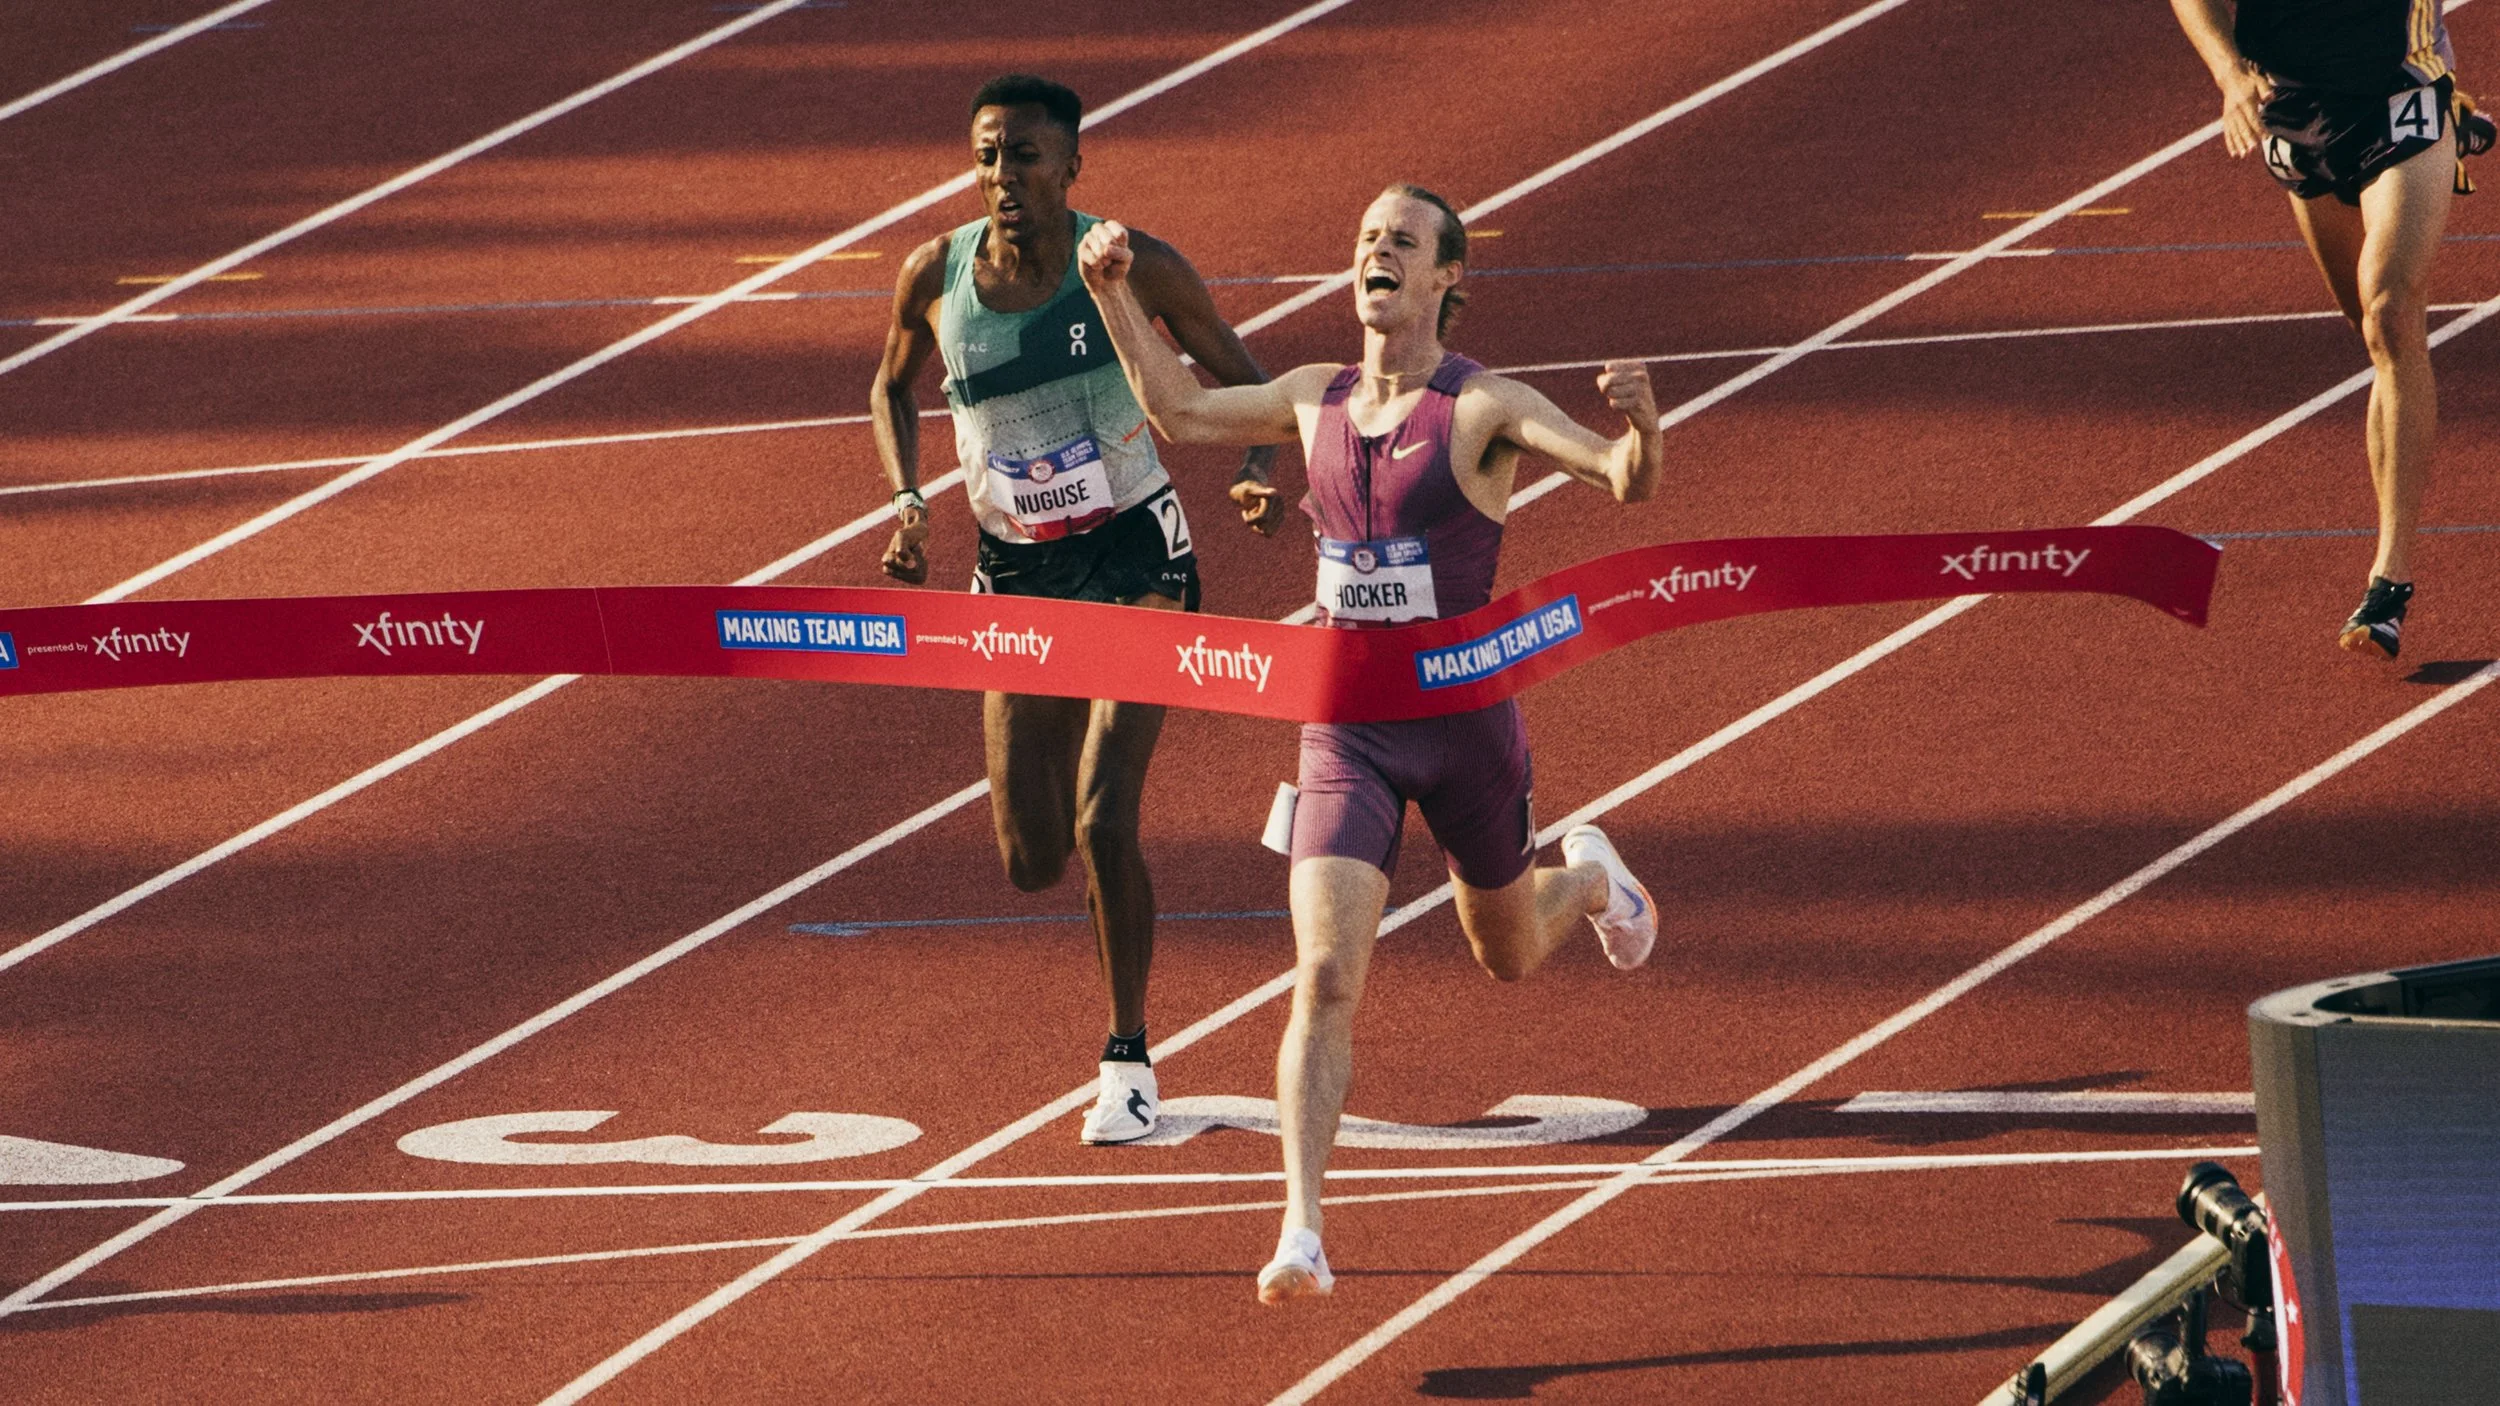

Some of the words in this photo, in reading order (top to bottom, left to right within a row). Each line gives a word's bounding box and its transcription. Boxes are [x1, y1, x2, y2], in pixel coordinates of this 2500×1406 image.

[2395, 91, 2429, 137] 4
[1013, 479, 1090, 516] NUGUSE
[1161, 499, 1189, 553] 2
[1940, 544, 2091, 581] xfinity
[1334, 582, 1408, 608] HOCKER
[27, 642, 74, 656] presented
[76, 642, 88, 653] by
[91, 626, 190, 662] xfinity
[352, 611, 485, 656] xfinity
[723, 616, 801, 643] MAKING
[804, 618, 856, 646] TEAM
[860, 621, 901, 649] USA
[916, 634, 957, 645] presented
[958, 635, 969, 648] by
[972, 621, 1054, 665] xfinity
[1422, 638, 1501, 683] MAKING
[1500, 619, 1540, 659] TEAM
[1540, 604, 1576, 640] USA
[1649, 561, 1758, 603] xfinity
[1176, 634, 1273, 694] xfinity
